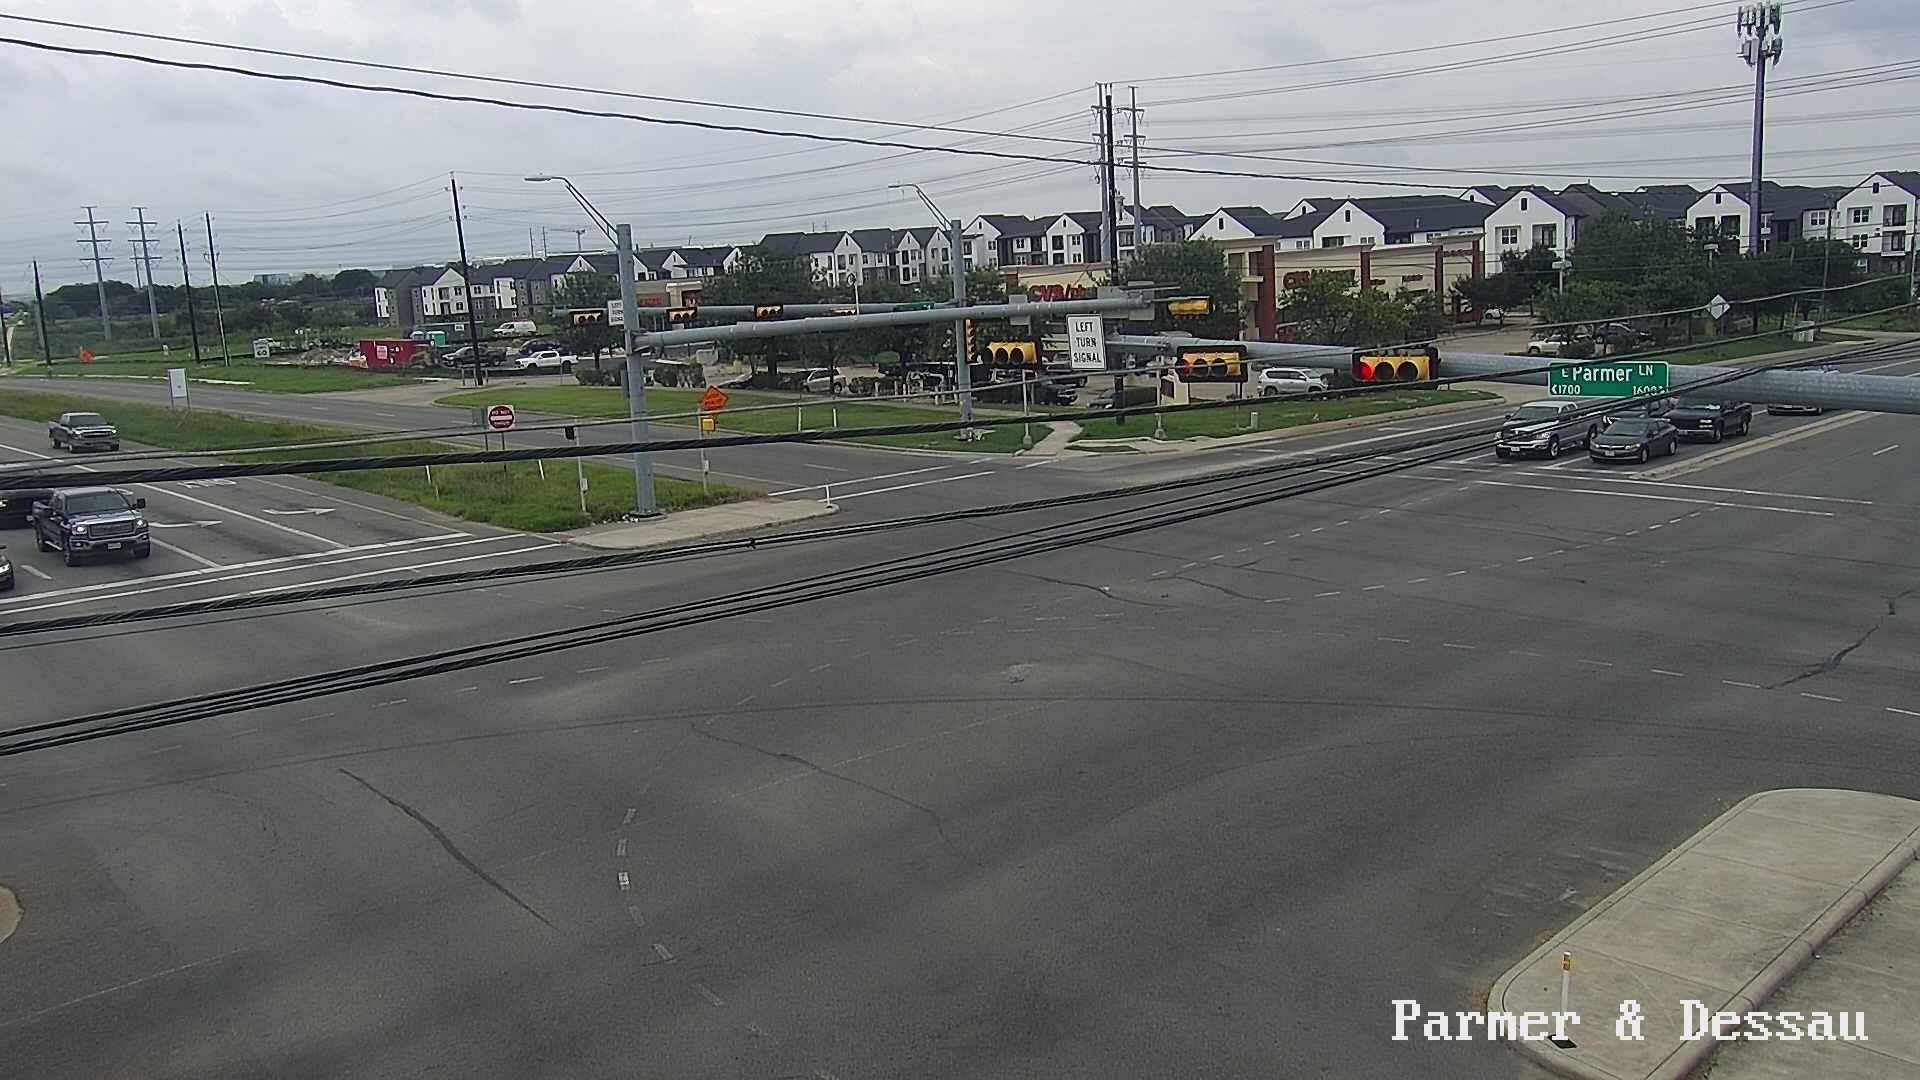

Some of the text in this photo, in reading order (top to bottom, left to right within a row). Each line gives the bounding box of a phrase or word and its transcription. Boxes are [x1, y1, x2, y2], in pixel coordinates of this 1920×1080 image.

[1075, 321, 1093, 332] LEFT
[1075, 337, 1097, 347] TURN
[1073, 352, 1102, 363] SIGNAL
[1573, 366, 1632, 381] Parmer
[1639, 365, 1653, 376] LN
